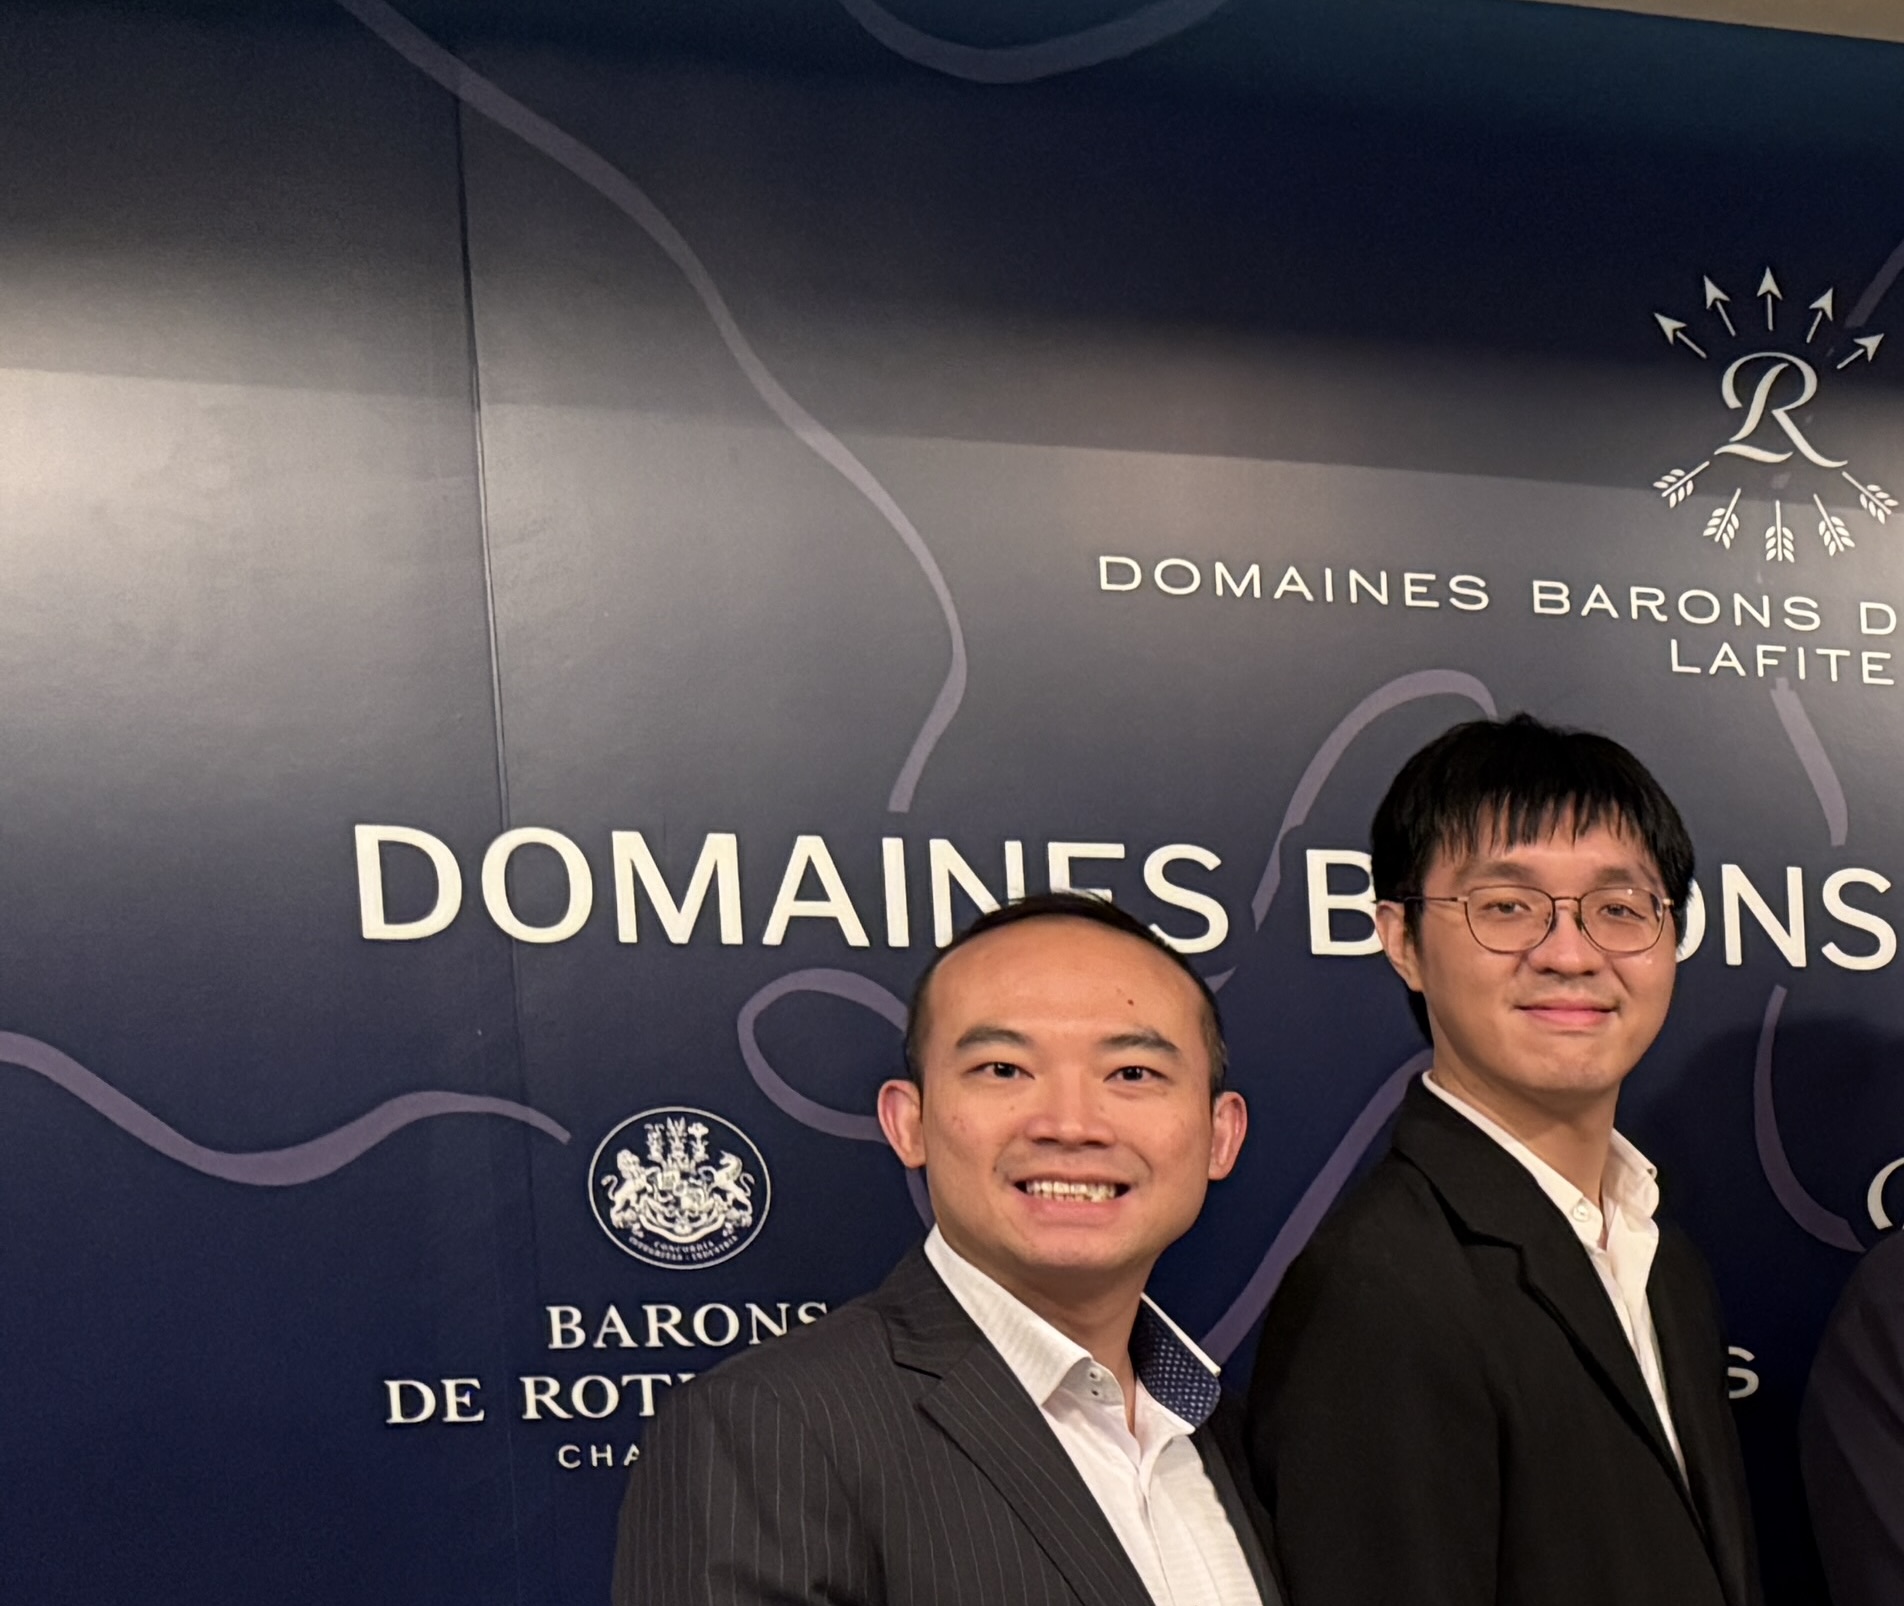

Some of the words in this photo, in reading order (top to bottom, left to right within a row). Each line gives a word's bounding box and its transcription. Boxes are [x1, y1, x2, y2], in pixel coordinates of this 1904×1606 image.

[1713, 351, 1849, 468] R
[1099, 555, 1490, 611] DOMAINES
[1532, 579, 1821, 632] BARONS
[1670, 638, 1895, 686] LAFITE
[384, 1379, 486, 1424] DE
